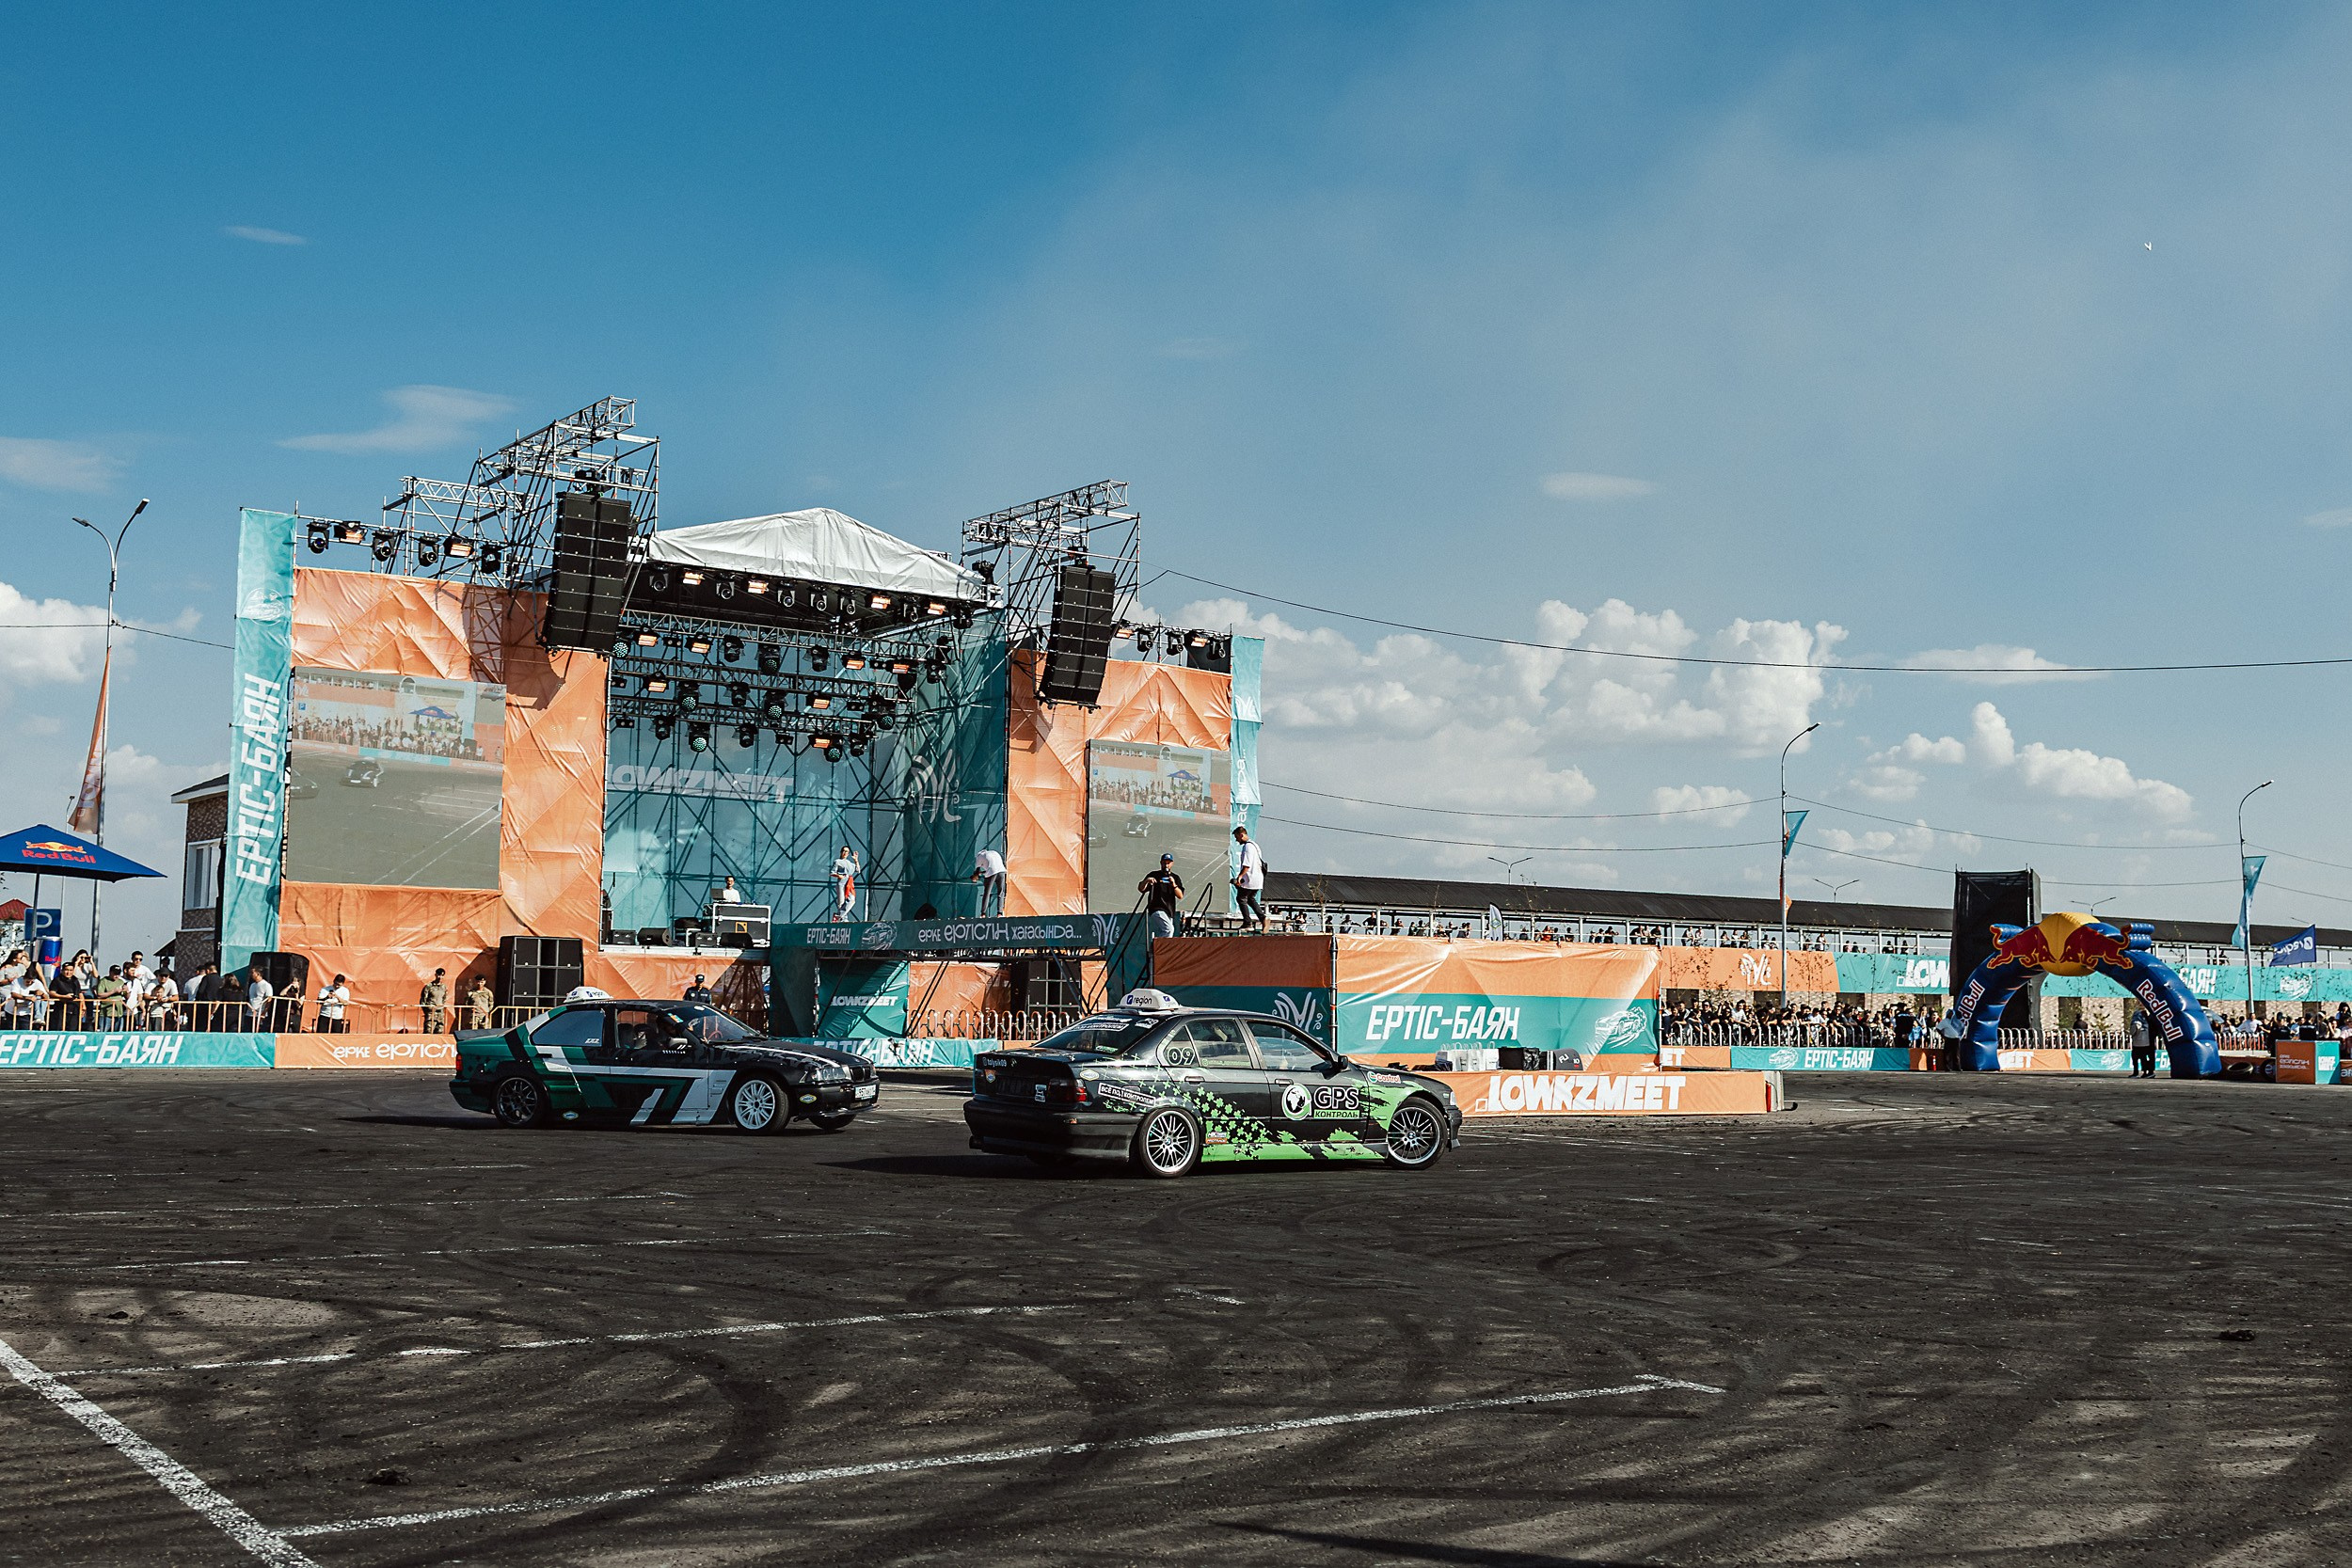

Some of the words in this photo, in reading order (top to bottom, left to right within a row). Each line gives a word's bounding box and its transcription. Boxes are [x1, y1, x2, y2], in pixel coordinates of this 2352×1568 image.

[235, 673, 281, 885] ЕРТІС-БАЯН
[608, 764, 794, 803] OWKZMEET
[22, 849, 59, 860] Red
[61, 852, 97, 864] Bull
[806, 927, 851, 944] ЕРТІС-БАЯН
[1133, 996, 1152, 1006] region
[1961, 978, 1985, 1011] Bull
[2137, 979, 2166, 1013] Red
[2156, 1004, 2184, 1042] Bull
[1366, 1006, 1520, 1040] ЕРТІС-БАЯН
[0, 1035, 184, 1065] ЕРТІС-БАЯН
[1168, 1047, 1195, 1066] 09
[1804, 1050, 1875, 1069] ЕРТІС-БАЯН
[1376, 1074, 1401, 1084] Castrol
[1123, 1091, 1153, 1104] КОНТРОЛЕМ
[1313, 1086, 1359, 1109] GPS
[1487, 1075, 1686, 1111] LOWKZMEET
